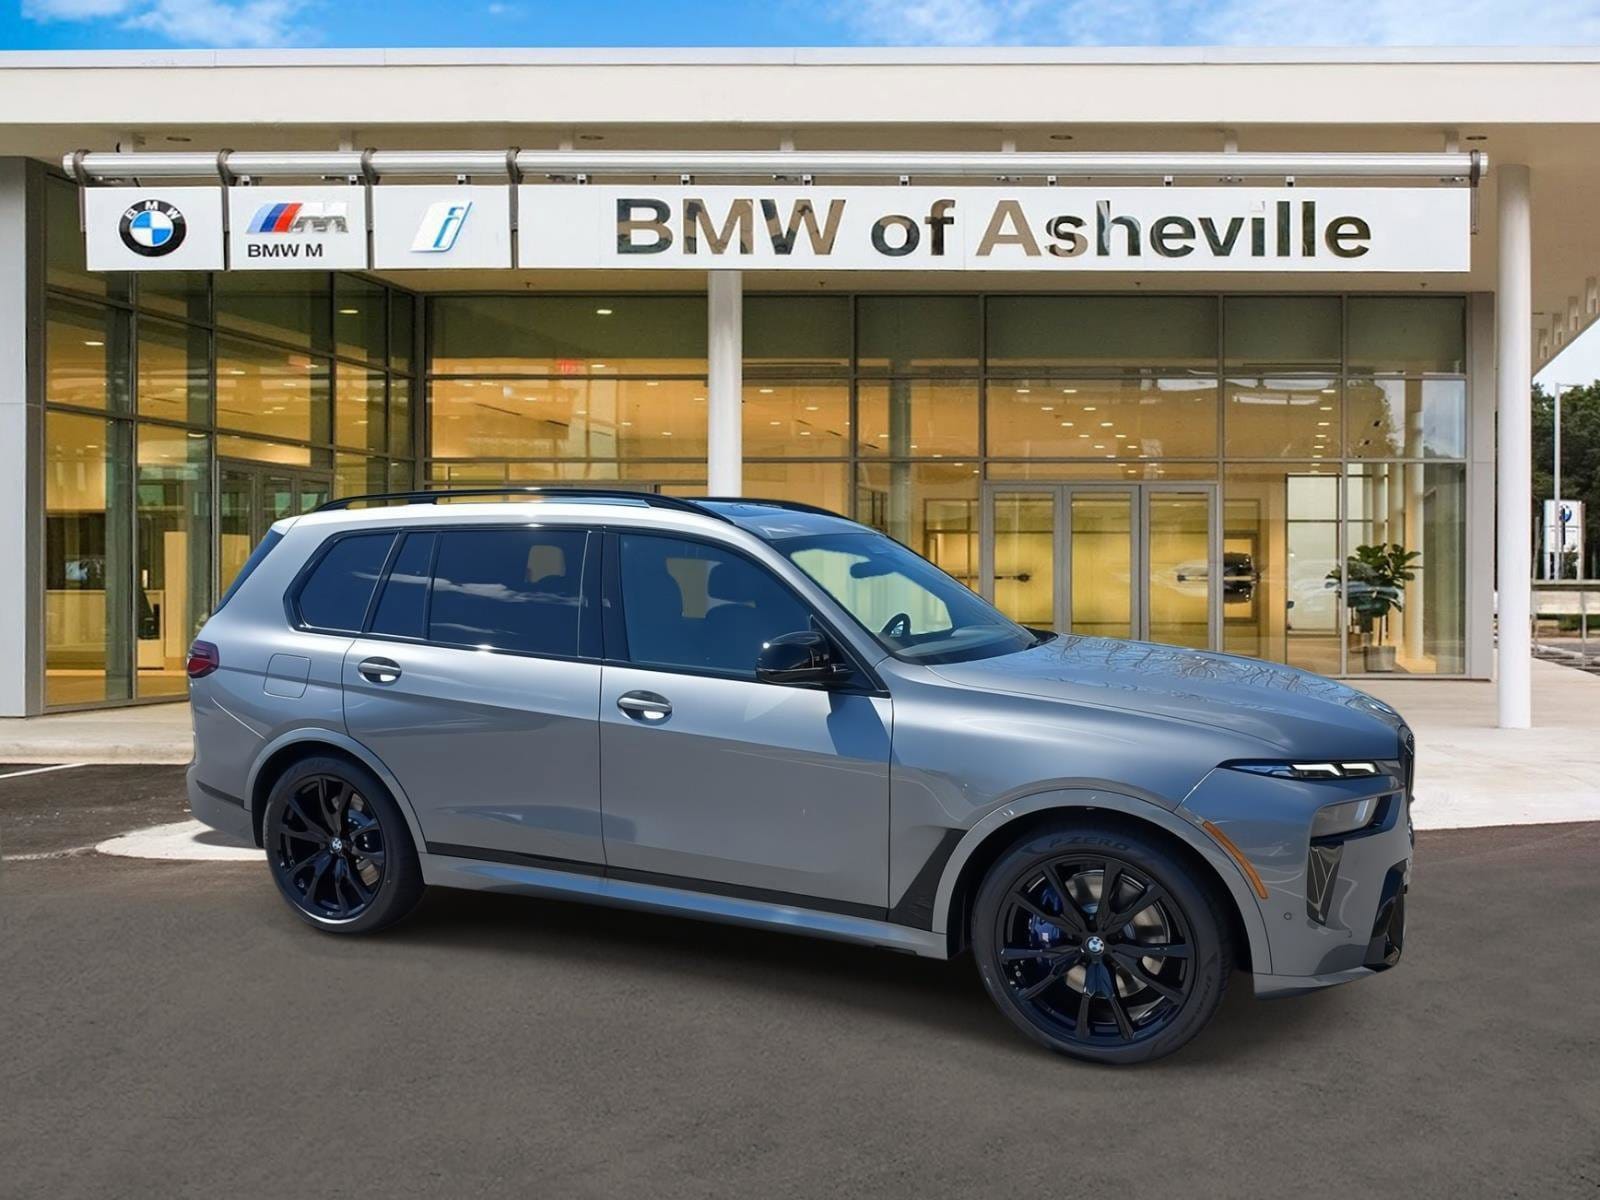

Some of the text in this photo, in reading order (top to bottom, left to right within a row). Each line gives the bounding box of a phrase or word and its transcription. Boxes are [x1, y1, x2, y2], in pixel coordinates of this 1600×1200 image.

[125, 200, 181, 220] BMW
[616, 198, 1372, 257] BMW of Asheville
[247, 243, 323, 258] BMW M
